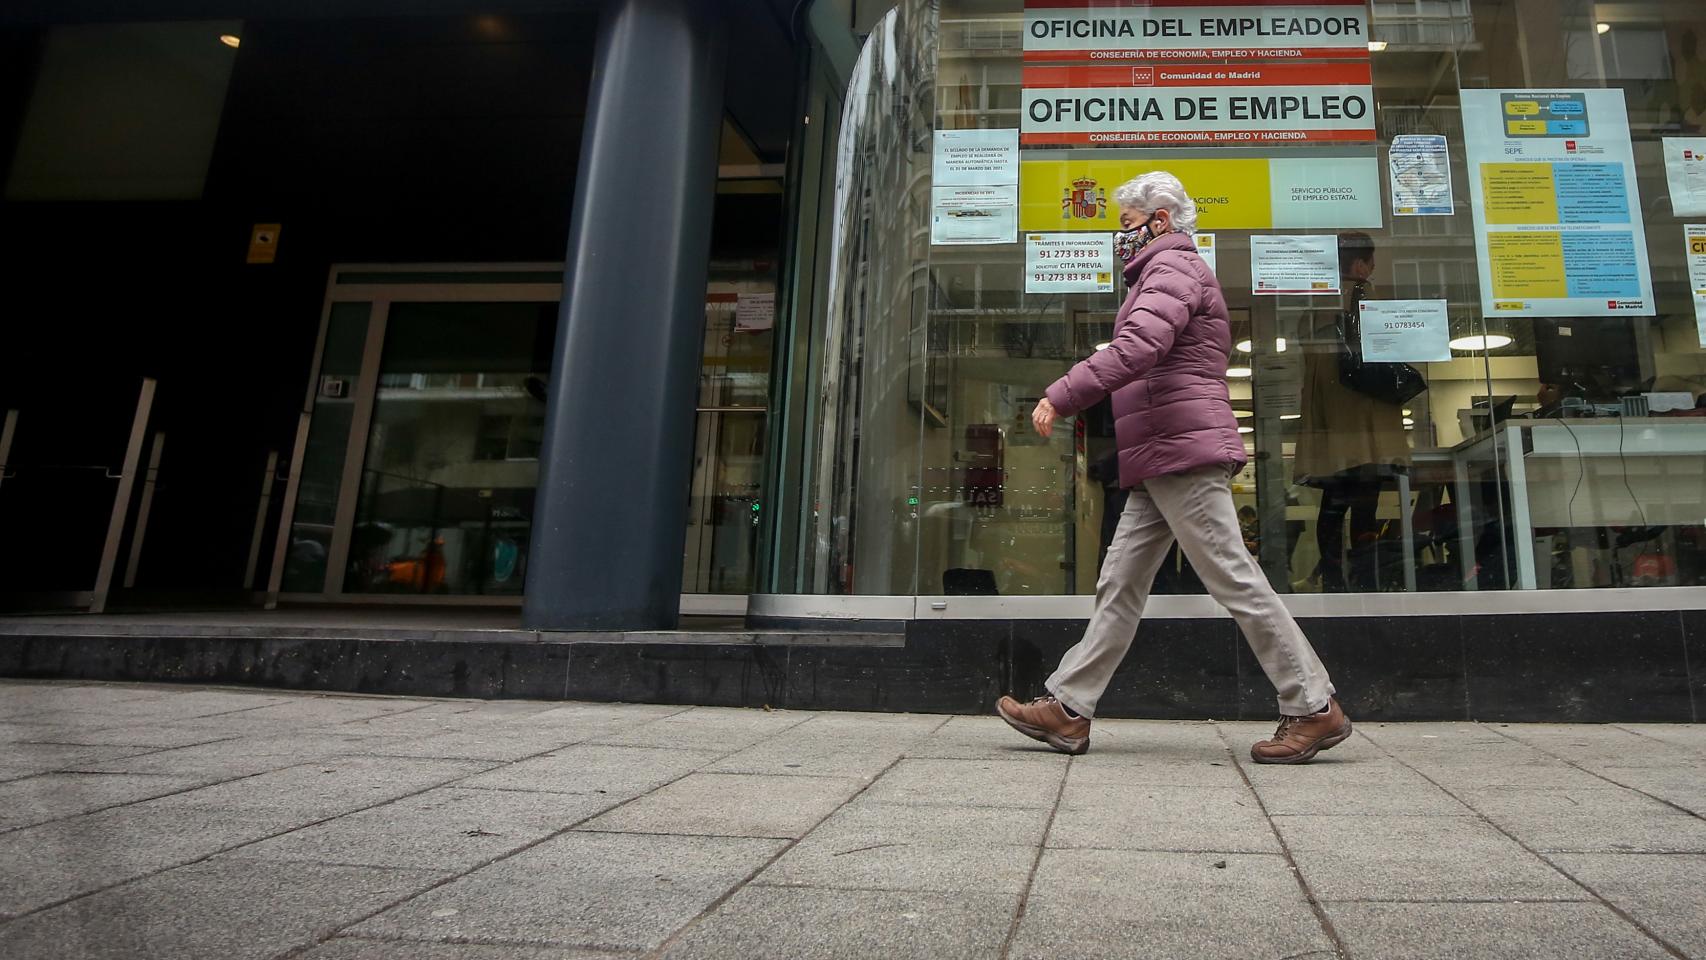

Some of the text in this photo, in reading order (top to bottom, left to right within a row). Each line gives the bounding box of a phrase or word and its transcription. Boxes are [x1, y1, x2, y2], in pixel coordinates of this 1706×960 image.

[1031, 17, 1361, 38] OFICINA DEL EMPLEADOR
[1090, 50, 1145, 59] CONSEJERÍA
[1160, 49, 1210, 59] ECONOMÍA,
[1212, 50, 1248, 58] EMPLEO
[1160, 71, 1261, 79] Comunidad de Madrid
[1029, 95, 1367, 122] OFICINA DE EMPLEO
[1090, 132, 1145, 142] CONSEJERÍA
[1161, 132, 1212, 141] ECONOMÍA,
[1261, 132, 1306, 140] HACIENDA
[1040, 250, 1099, 258] 91 273 83 83
[1034, 274, 1045, 282] 91
[1080, 273, 1092, 281] 84
[1394, 321, 1425, 329] 0783454
